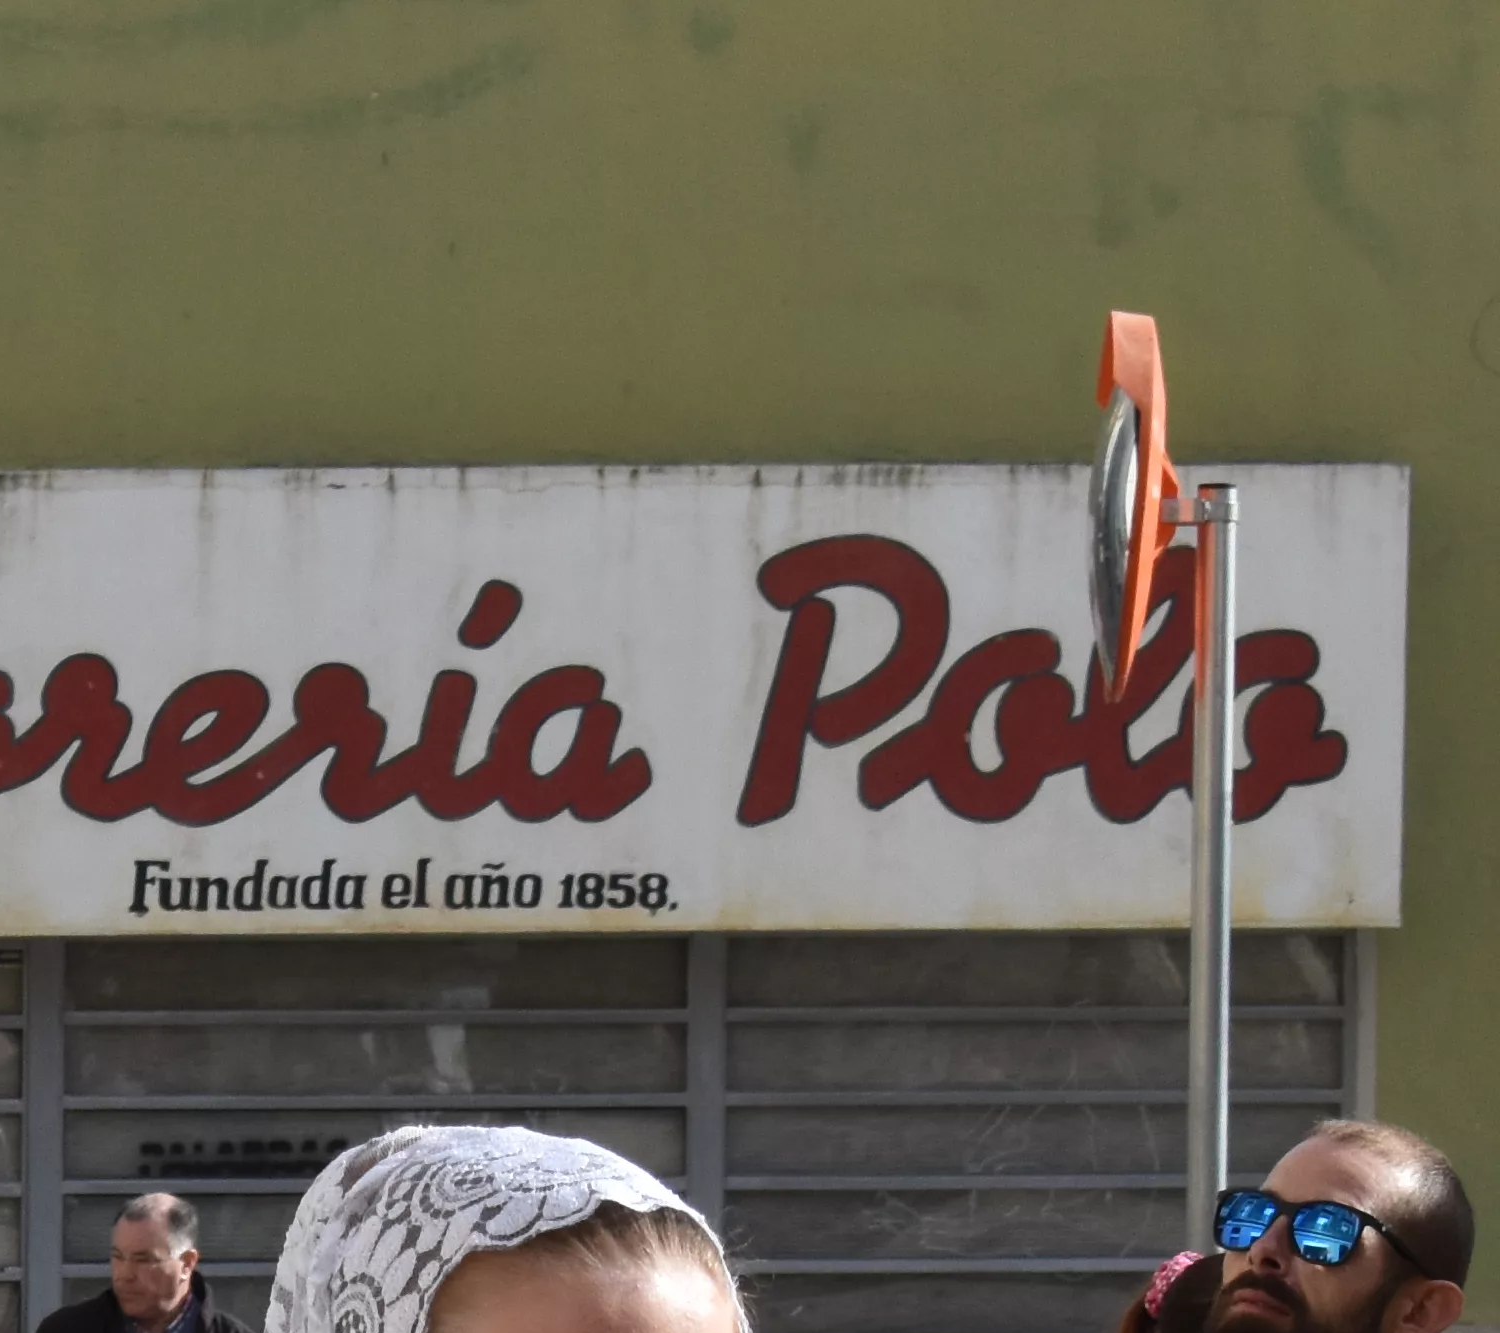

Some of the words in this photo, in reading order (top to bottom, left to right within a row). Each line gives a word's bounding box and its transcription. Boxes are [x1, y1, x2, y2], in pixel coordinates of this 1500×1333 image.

[737, 533, 1348, 827] Polo
[128, 858, 367, 918] Fundada
[381, 857, 432, 909] el
[442, 861, 543, 910] año
